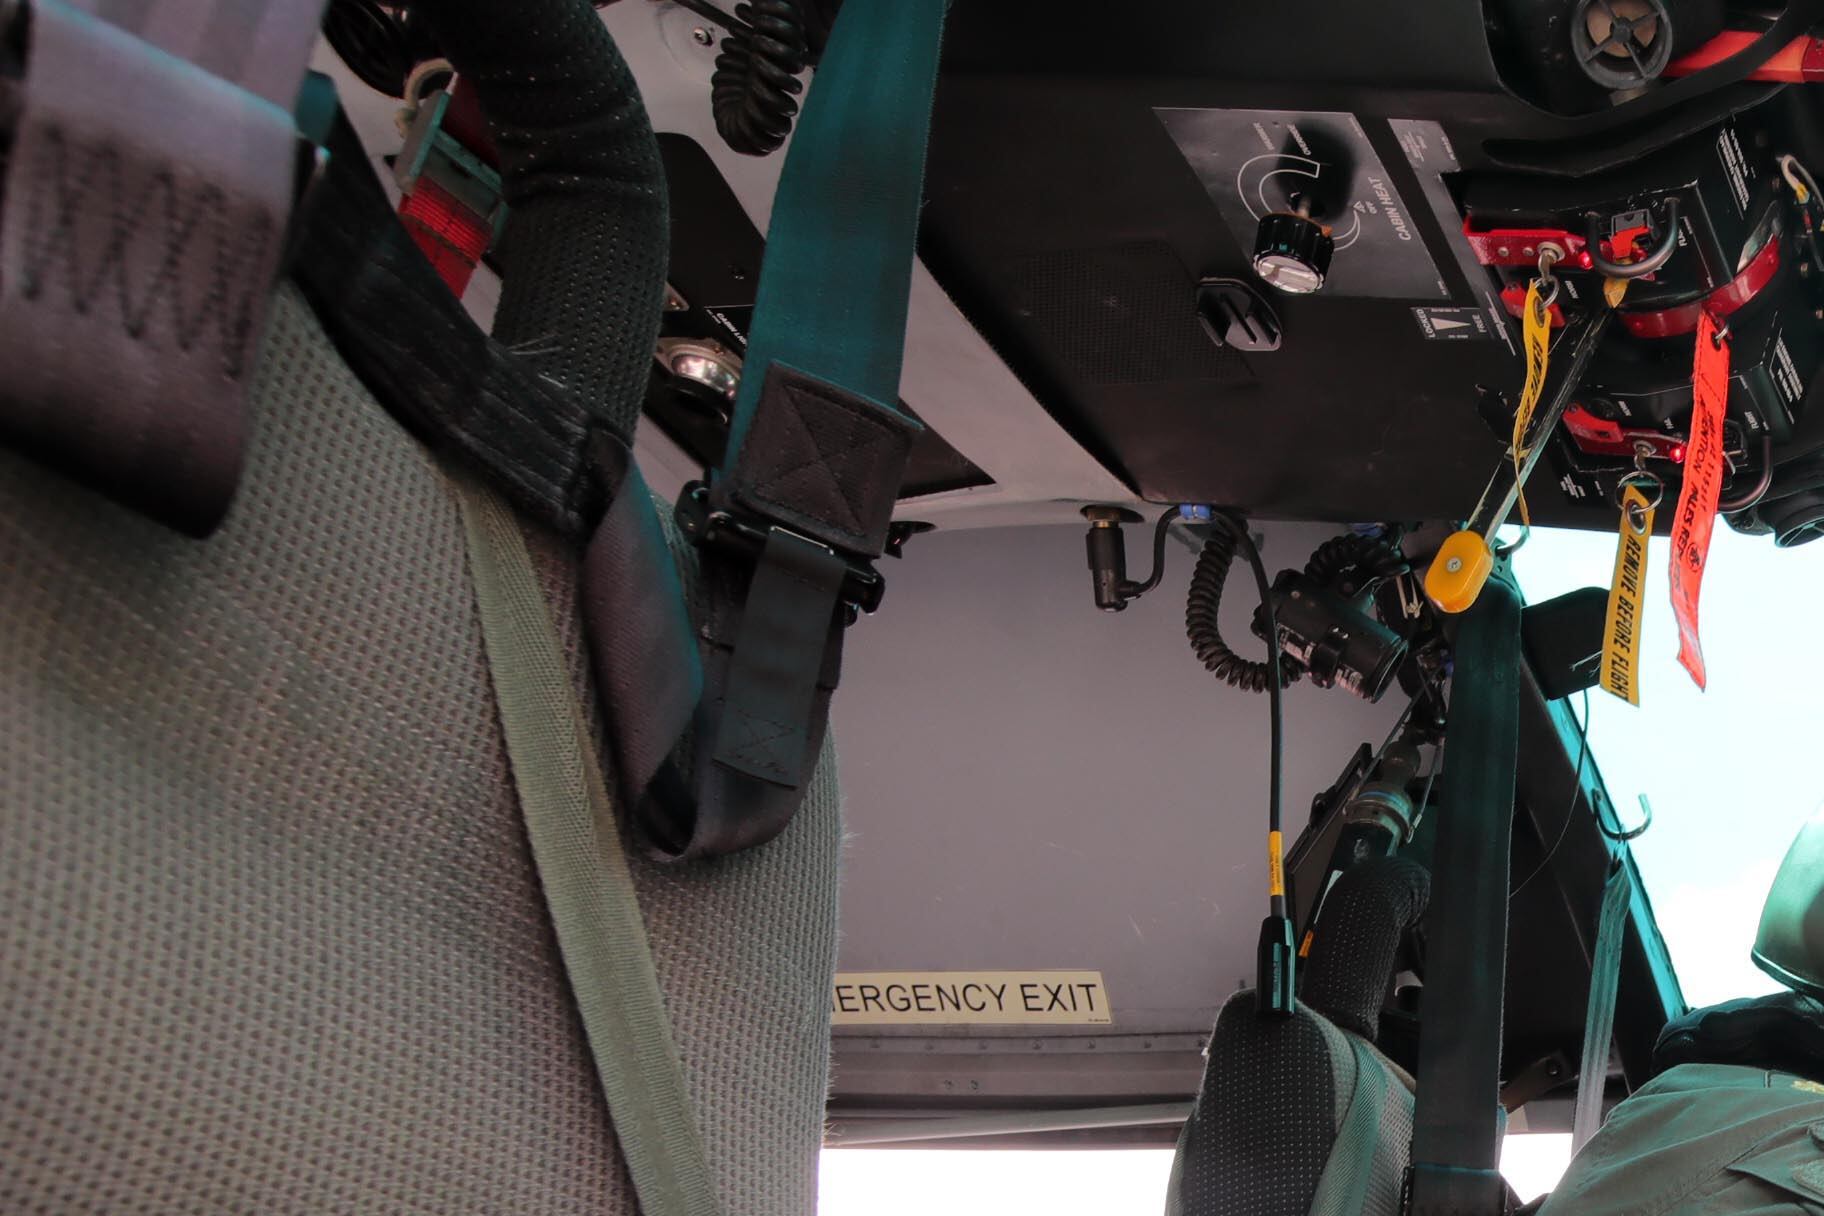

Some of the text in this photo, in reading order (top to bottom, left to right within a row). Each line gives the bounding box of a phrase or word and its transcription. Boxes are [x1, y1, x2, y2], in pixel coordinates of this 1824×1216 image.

[1368, 177, 1412, 241] CABIN HEAT
[716, 313, 738, 332] CABIN
[1416, 308, 1436, 338] LOCKED
[1611, 535, 1642, 702] REMOVE BEFORE FLIGHT
[832, 983, 1097, 1012] ERGENCY EXIT
